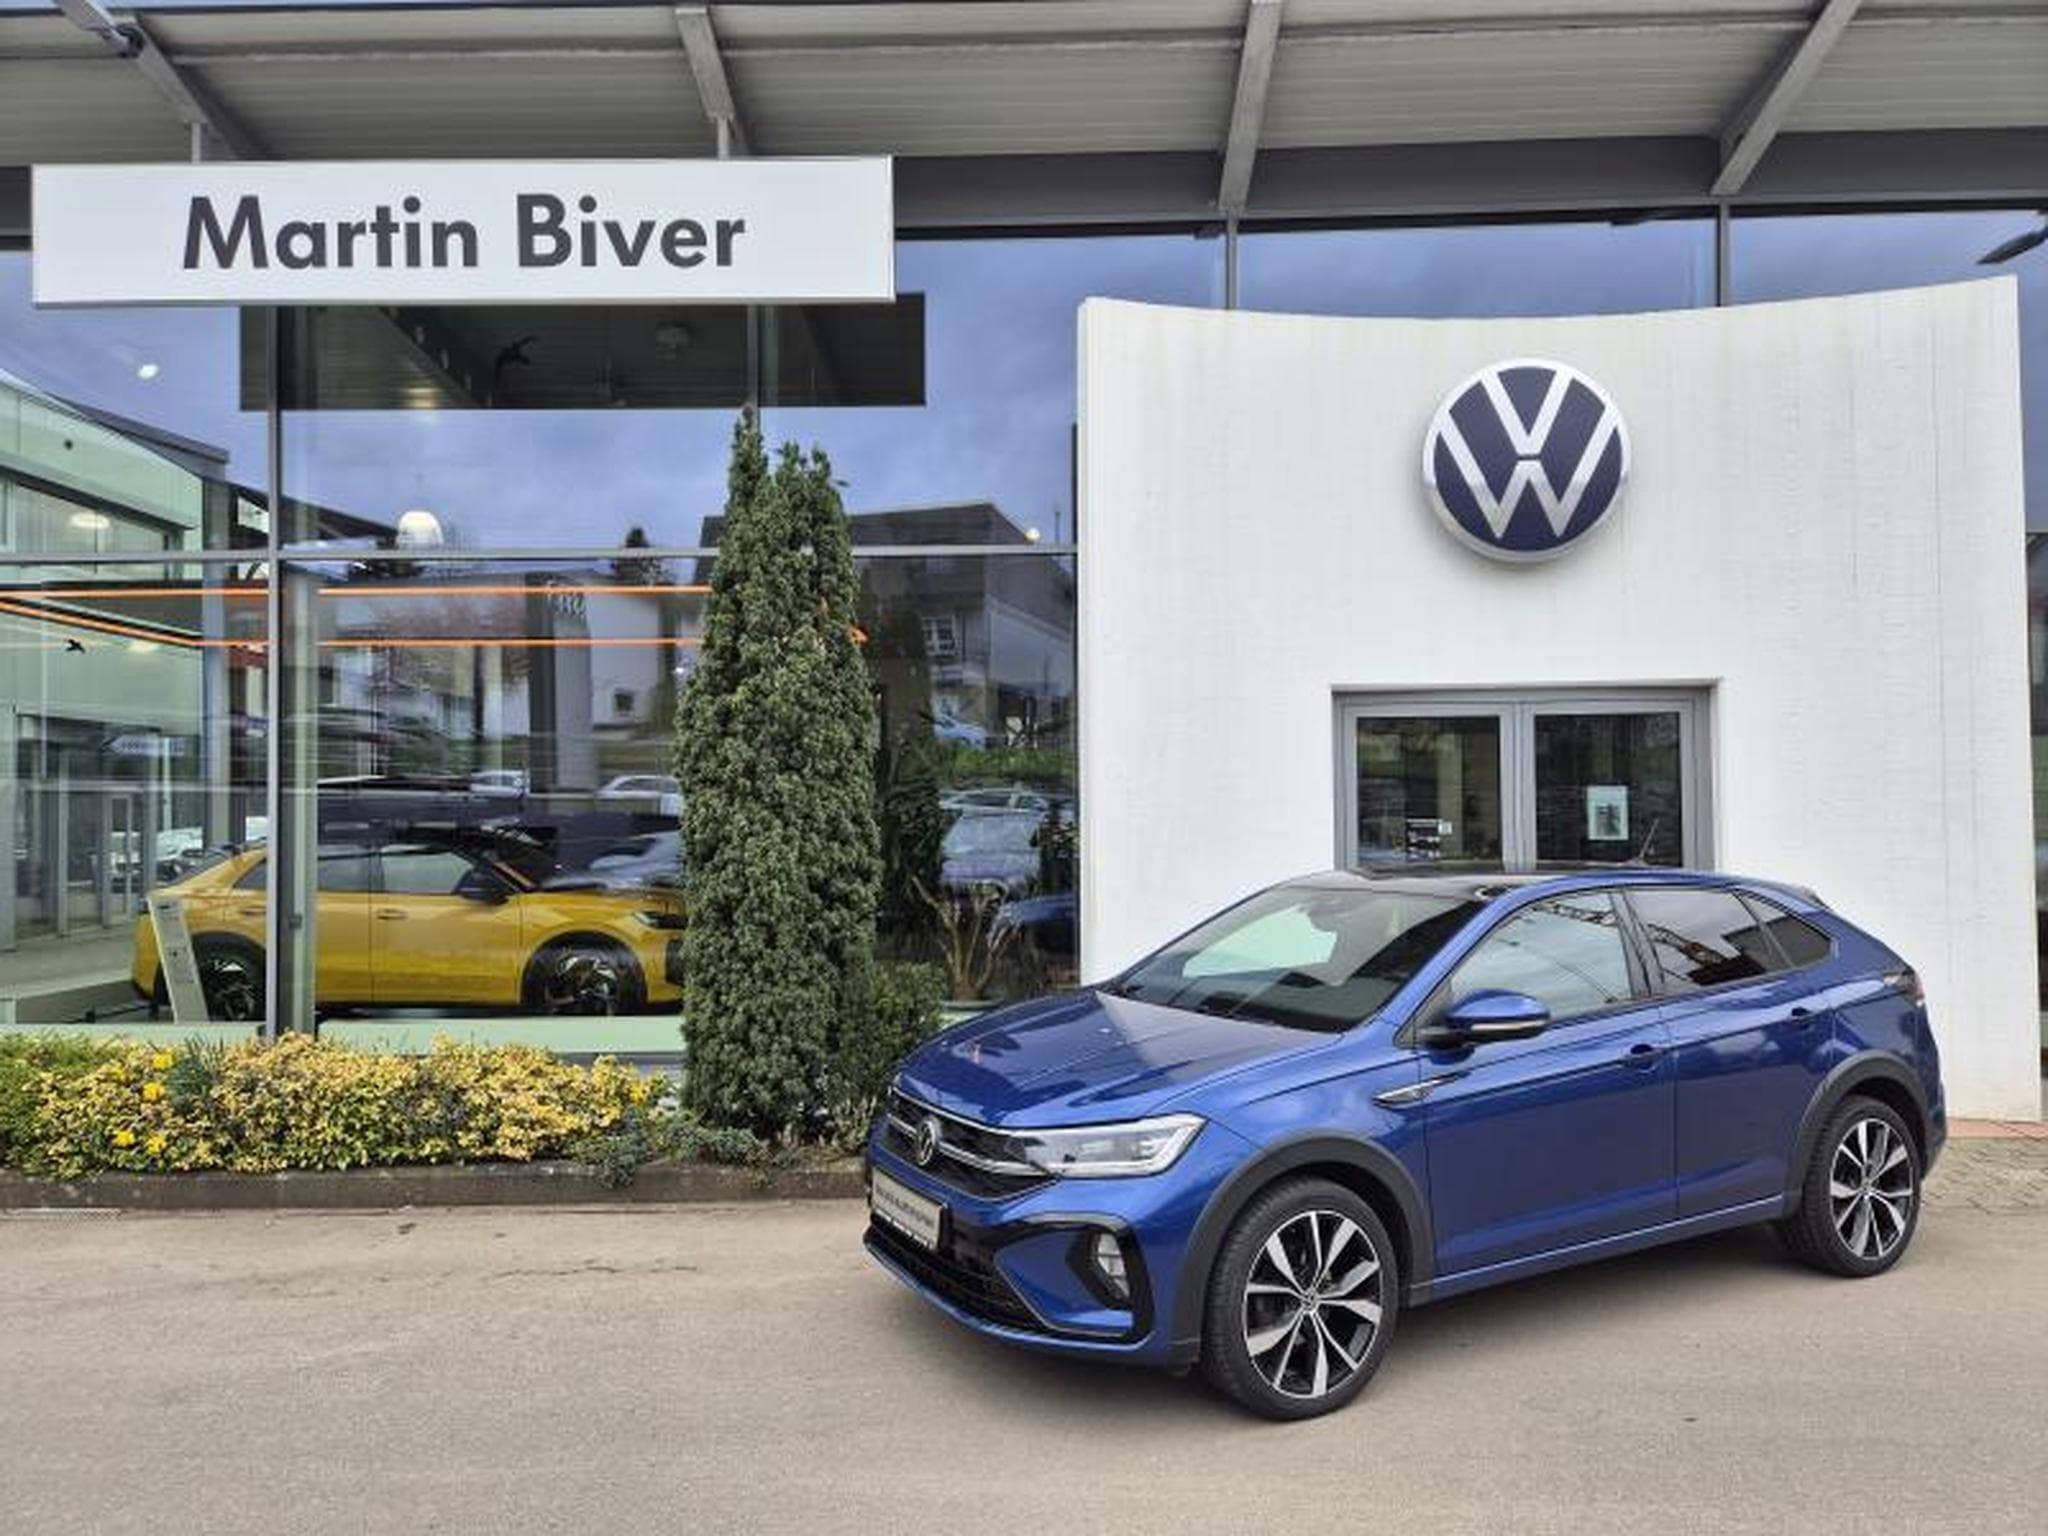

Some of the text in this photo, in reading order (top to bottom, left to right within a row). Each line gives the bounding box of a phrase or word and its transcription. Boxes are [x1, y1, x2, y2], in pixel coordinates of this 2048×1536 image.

[182, 193, 747, 271] Martin Biver
[1434, 365, 1621, 540] VW
